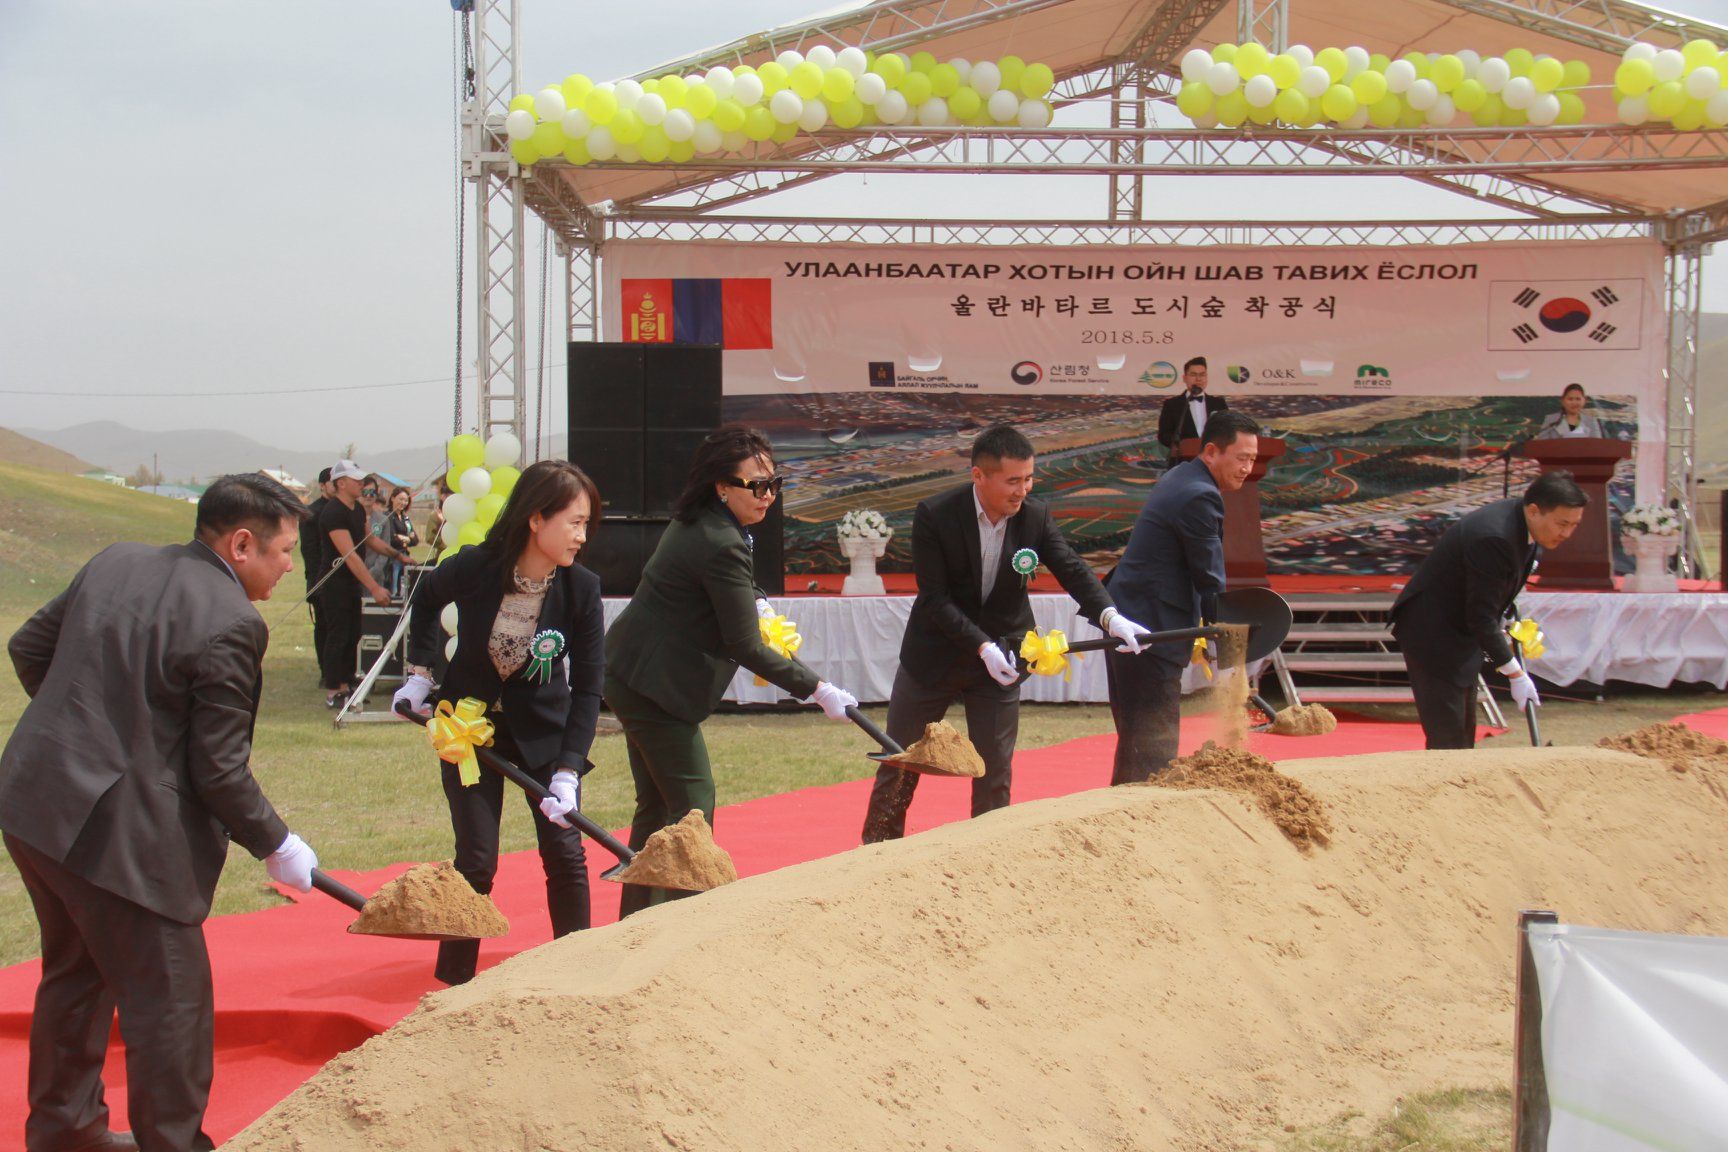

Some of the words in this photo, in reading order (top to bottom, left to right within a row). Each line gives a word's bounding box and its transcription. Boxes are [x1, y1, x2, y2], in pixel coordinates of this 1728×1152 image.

[784, 261, 1001, 278] УЛААНБААТАР
[1008, 264, 1114, 280] ХОТЫН
[1123, 261, 1185, 280] ОЙН
[1194, 265, 1264, 280] ШАВ
[1272, 265, 1369, 280] ТАВИХ
[1377, 261, 1478, 280] ЁСЛОЛ
[950, 294, 1113, 318] 울란바타르
[1131, 295, 1226, 319] 도시숲
[1244, 295, 1336, 319] 착공식
[1081, 330, 1175, 345] 2018.5.8
[1050, 364, 1090, 376] 산림청
[1262, 368, 1296, 379] O&K
